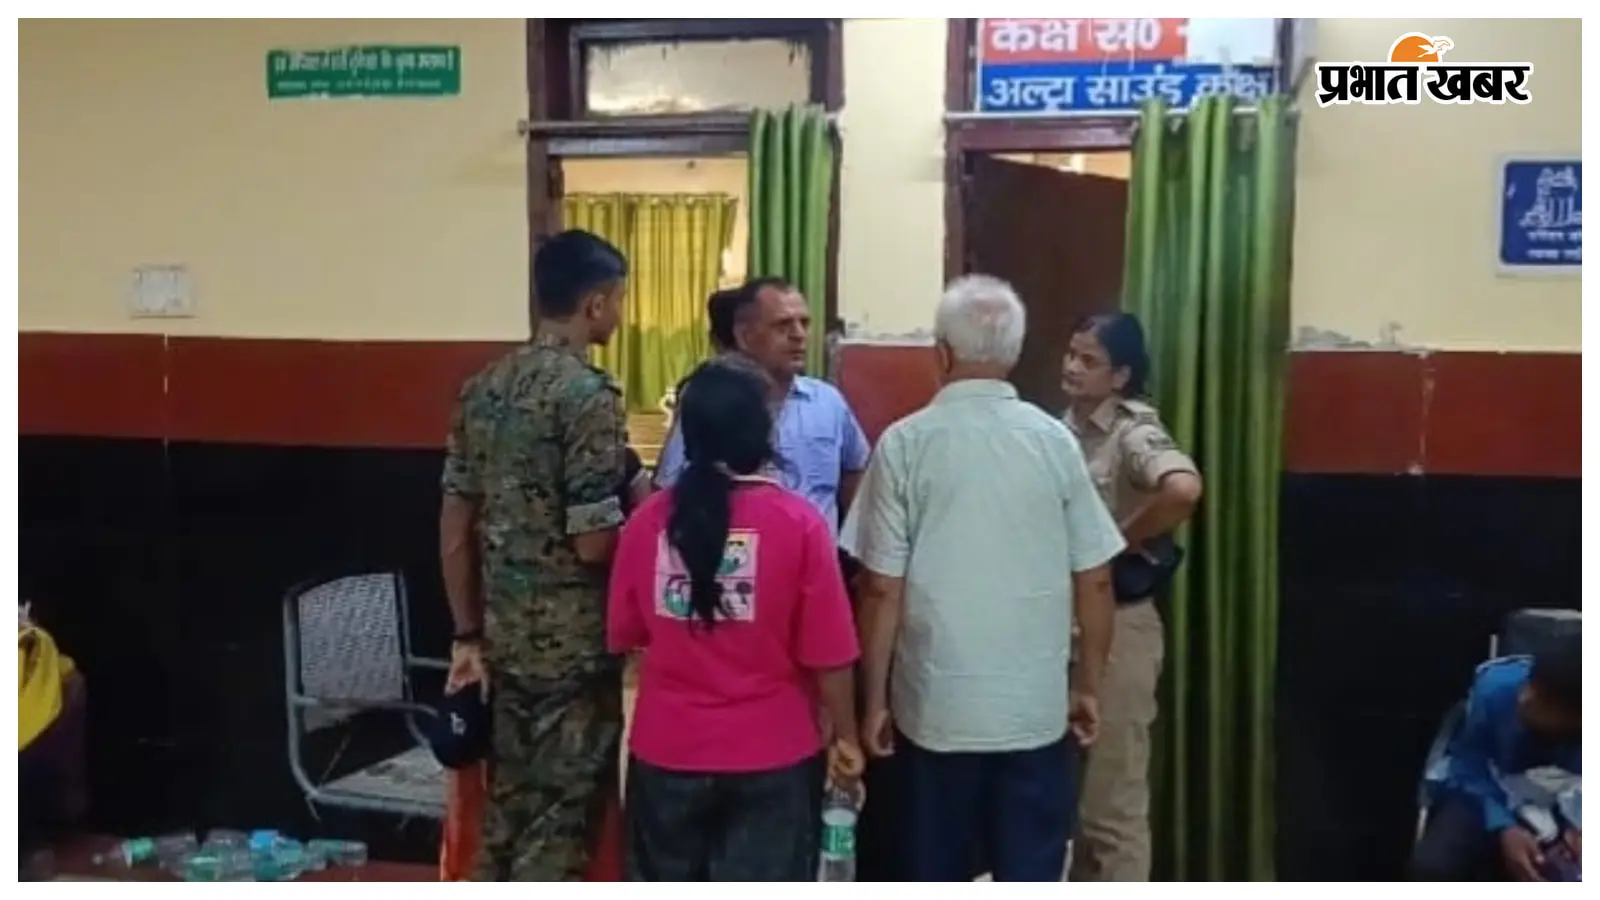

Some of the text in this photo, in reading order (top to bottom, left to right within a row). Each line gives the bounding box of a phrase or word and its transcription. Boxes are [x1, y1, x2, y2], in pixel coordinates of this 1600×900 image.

[989, 19, 1079, 53] कक्ष
[985, 76, 1075, 111] अल्ट्रा
[1084, 64, 1187, 106] साउंड
